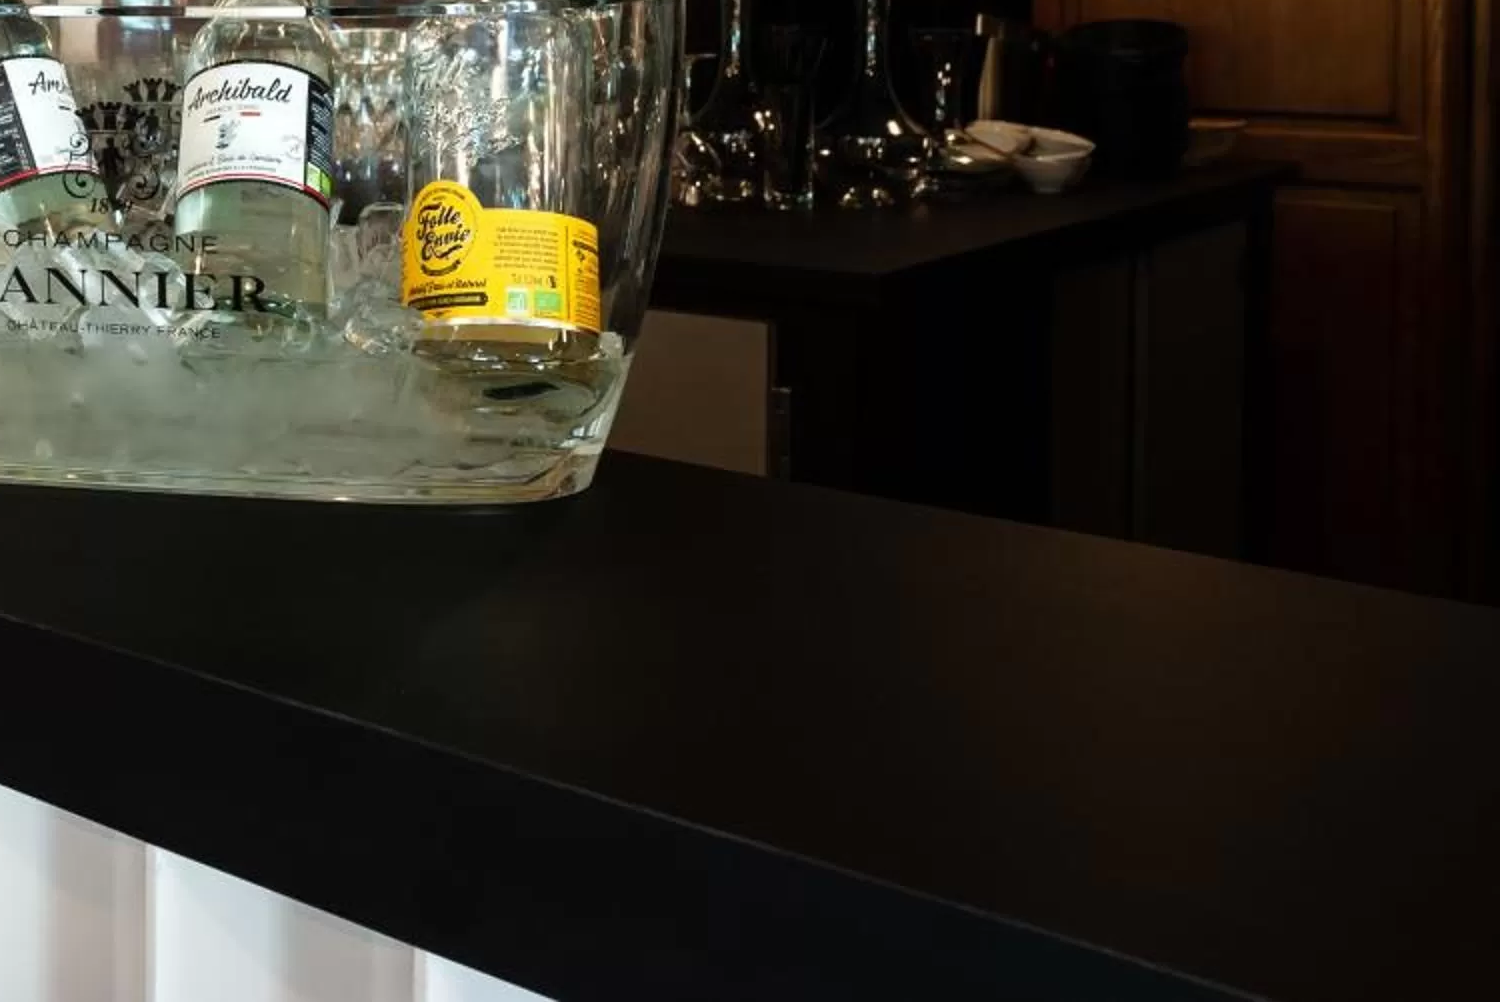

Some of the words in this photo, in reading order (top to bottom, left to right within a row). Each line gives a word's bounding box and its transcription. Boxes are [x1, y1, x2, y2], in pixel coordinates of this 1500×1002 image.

[188, 77, 293, 116] Archibald
[91, 197, 132, 214] 189
[417, 202, 461, 240] Folle
[3, 228, 220, 254] CHAMPAGNE
[421, 222, 471, 261] Envie
[156, 325, 222, 340] FRANCE
